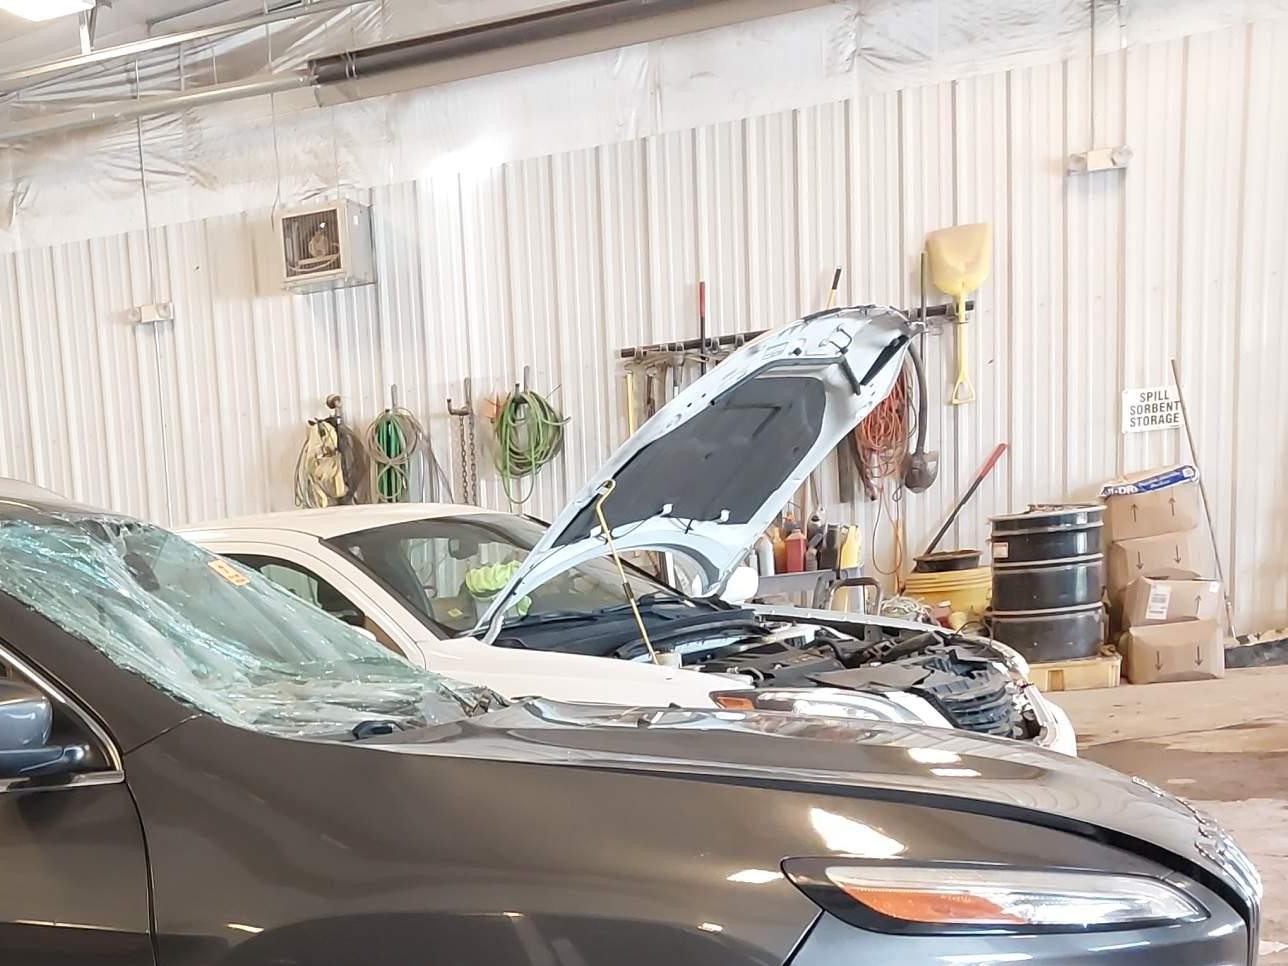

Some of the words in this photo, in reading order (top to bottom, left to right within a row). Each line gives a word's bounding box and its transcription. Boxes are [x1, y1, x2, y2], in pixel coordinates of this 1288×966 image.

[1140, 390, 1169, 402] SPILL
[1130, 401, 1181, 416] SORBENT
[1130, 412, 1179, 427] STORAGE
